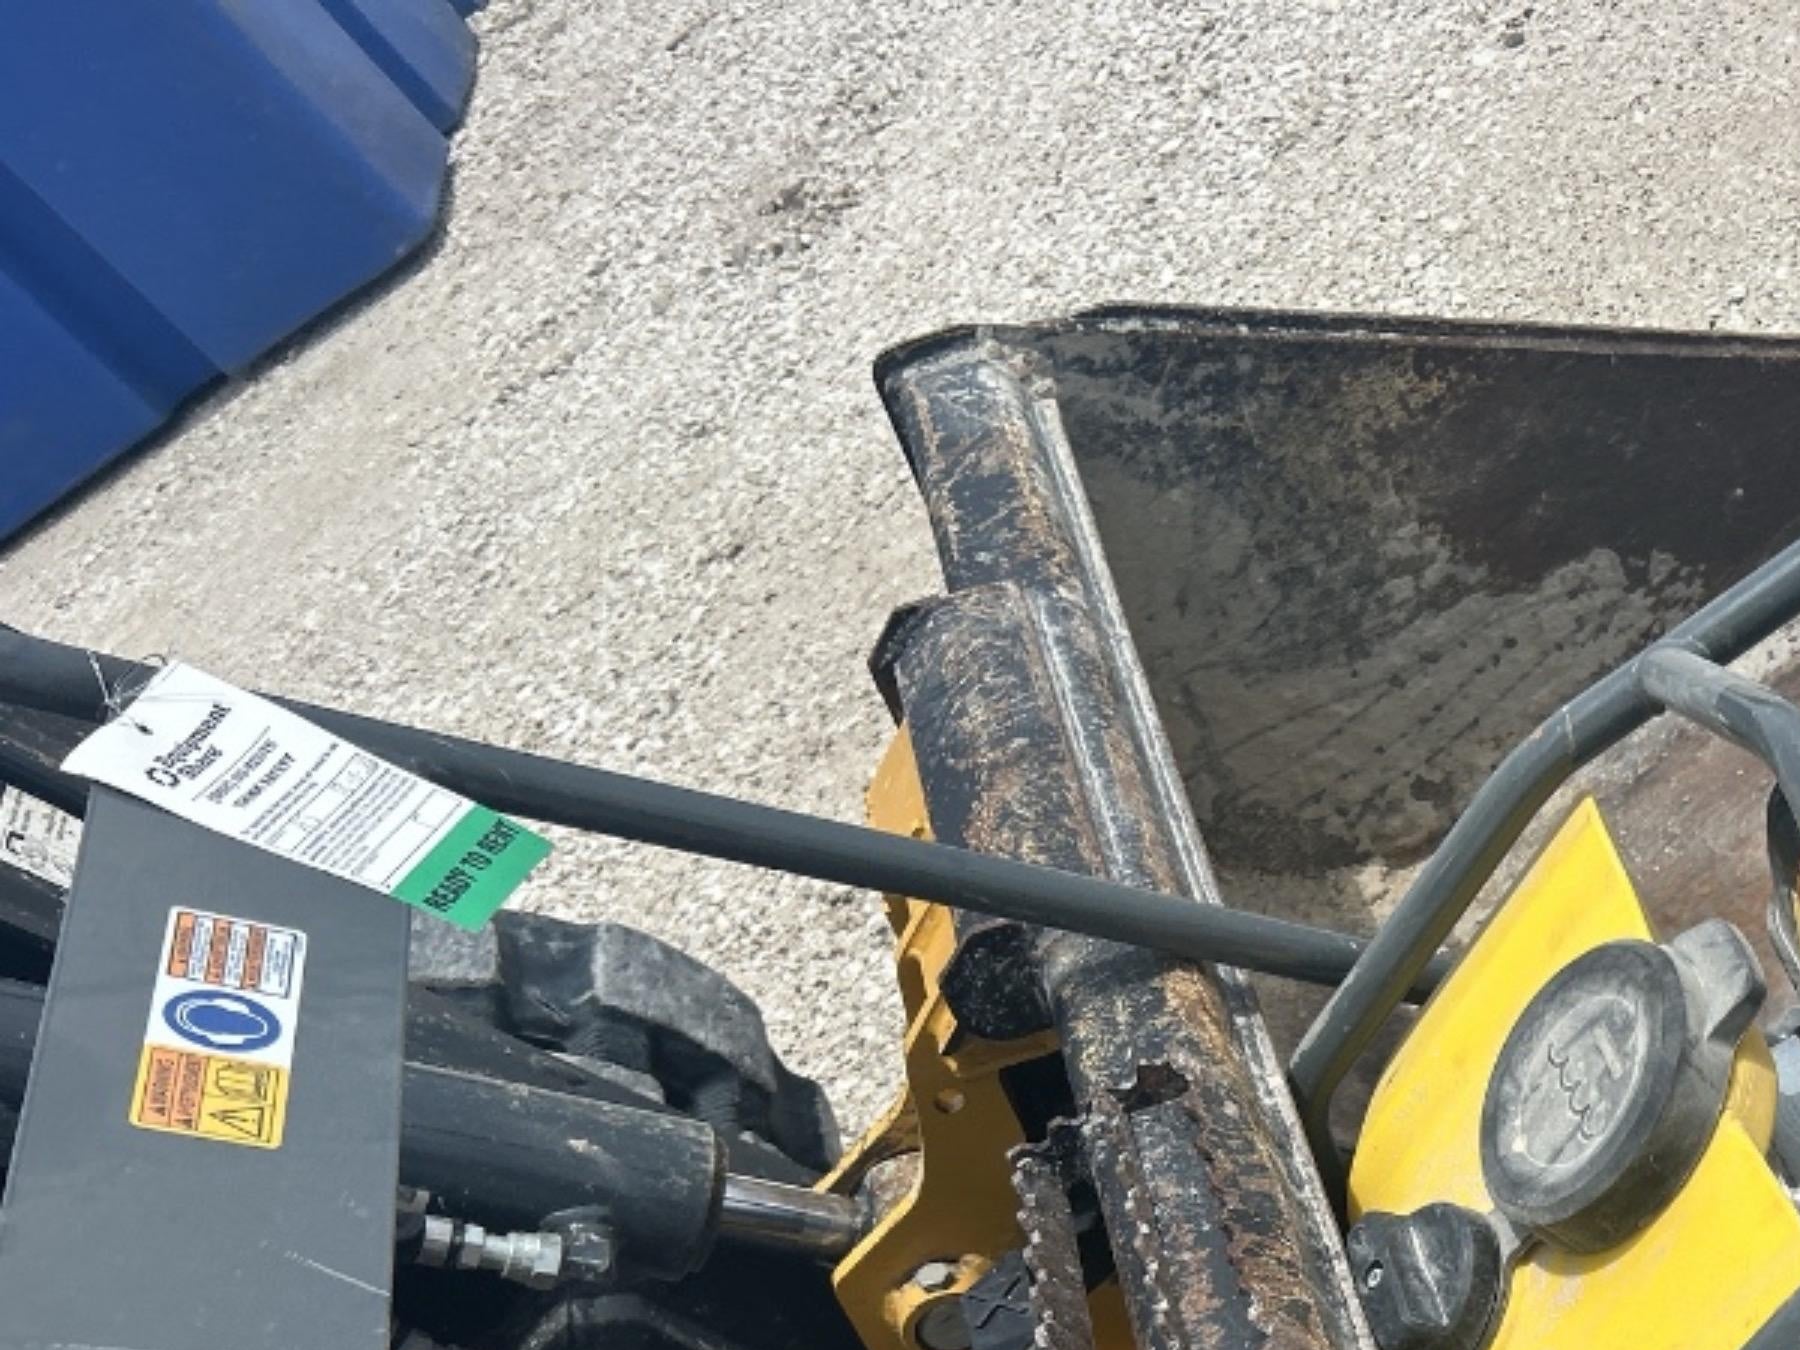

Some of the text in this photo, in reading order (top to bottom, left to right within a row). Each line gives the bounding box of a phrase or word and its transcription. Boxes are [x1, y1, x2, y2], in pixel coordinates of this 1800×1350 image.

[422, 817, 521, 912] READY TO RENT
